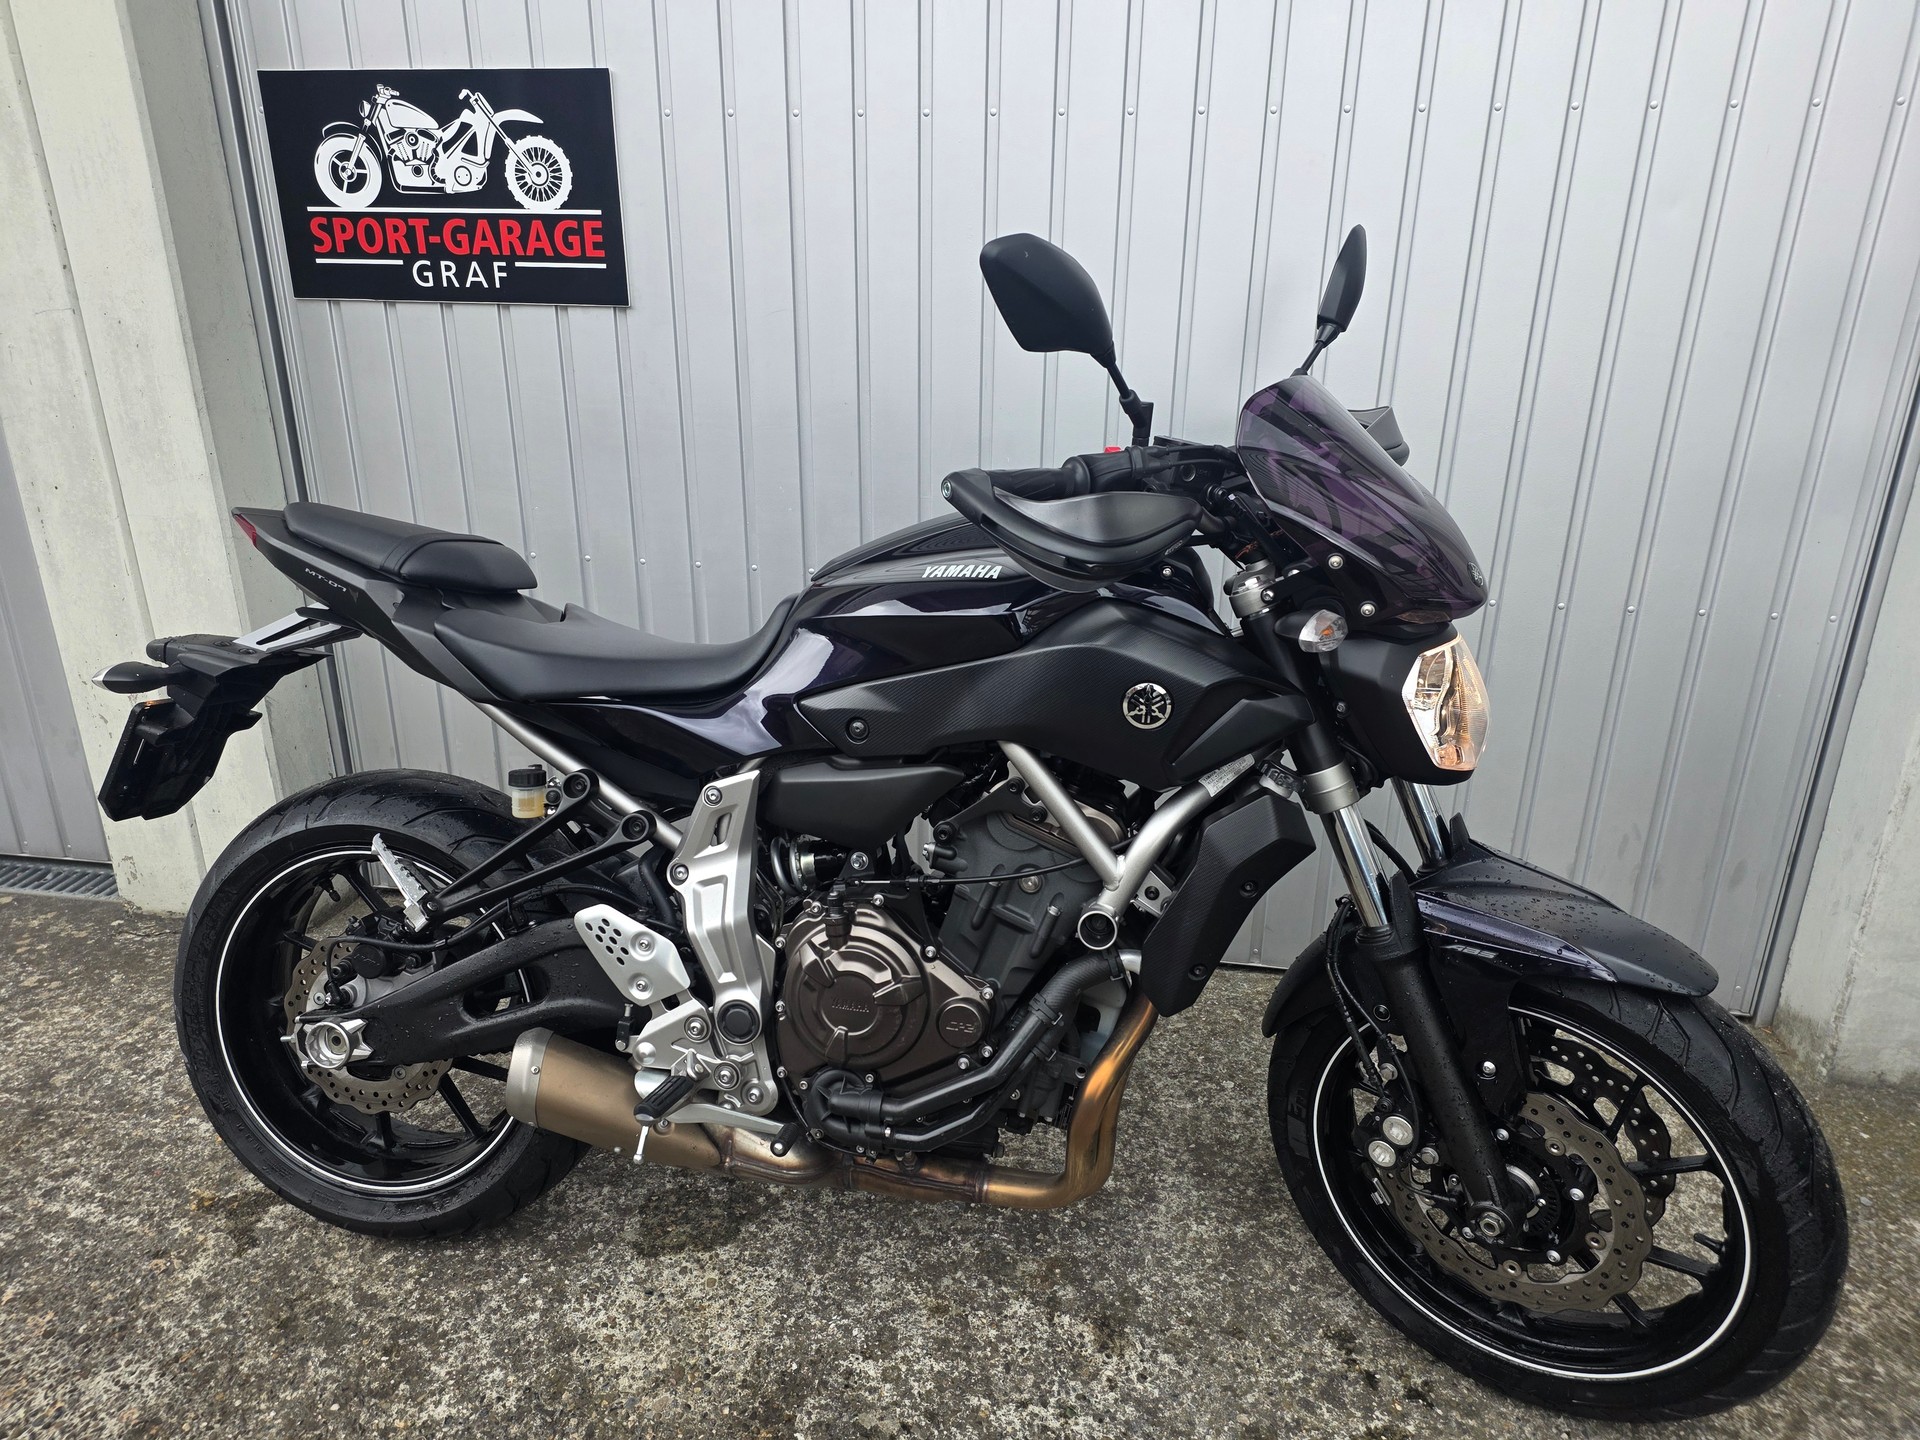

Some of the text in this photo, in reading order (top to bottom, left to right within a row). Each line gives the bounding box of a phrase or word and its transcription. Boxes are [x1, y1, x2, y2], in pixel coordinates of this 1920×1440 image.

[309, 216, 606, 258] SPORT-GARAGE
[412, 260, 508, 289] GRAF
[304, 567, 347, 592] MT-07
[921, 564, 1003, 580] YAMAHA
[1442, 944, 1499, 959] ABS
